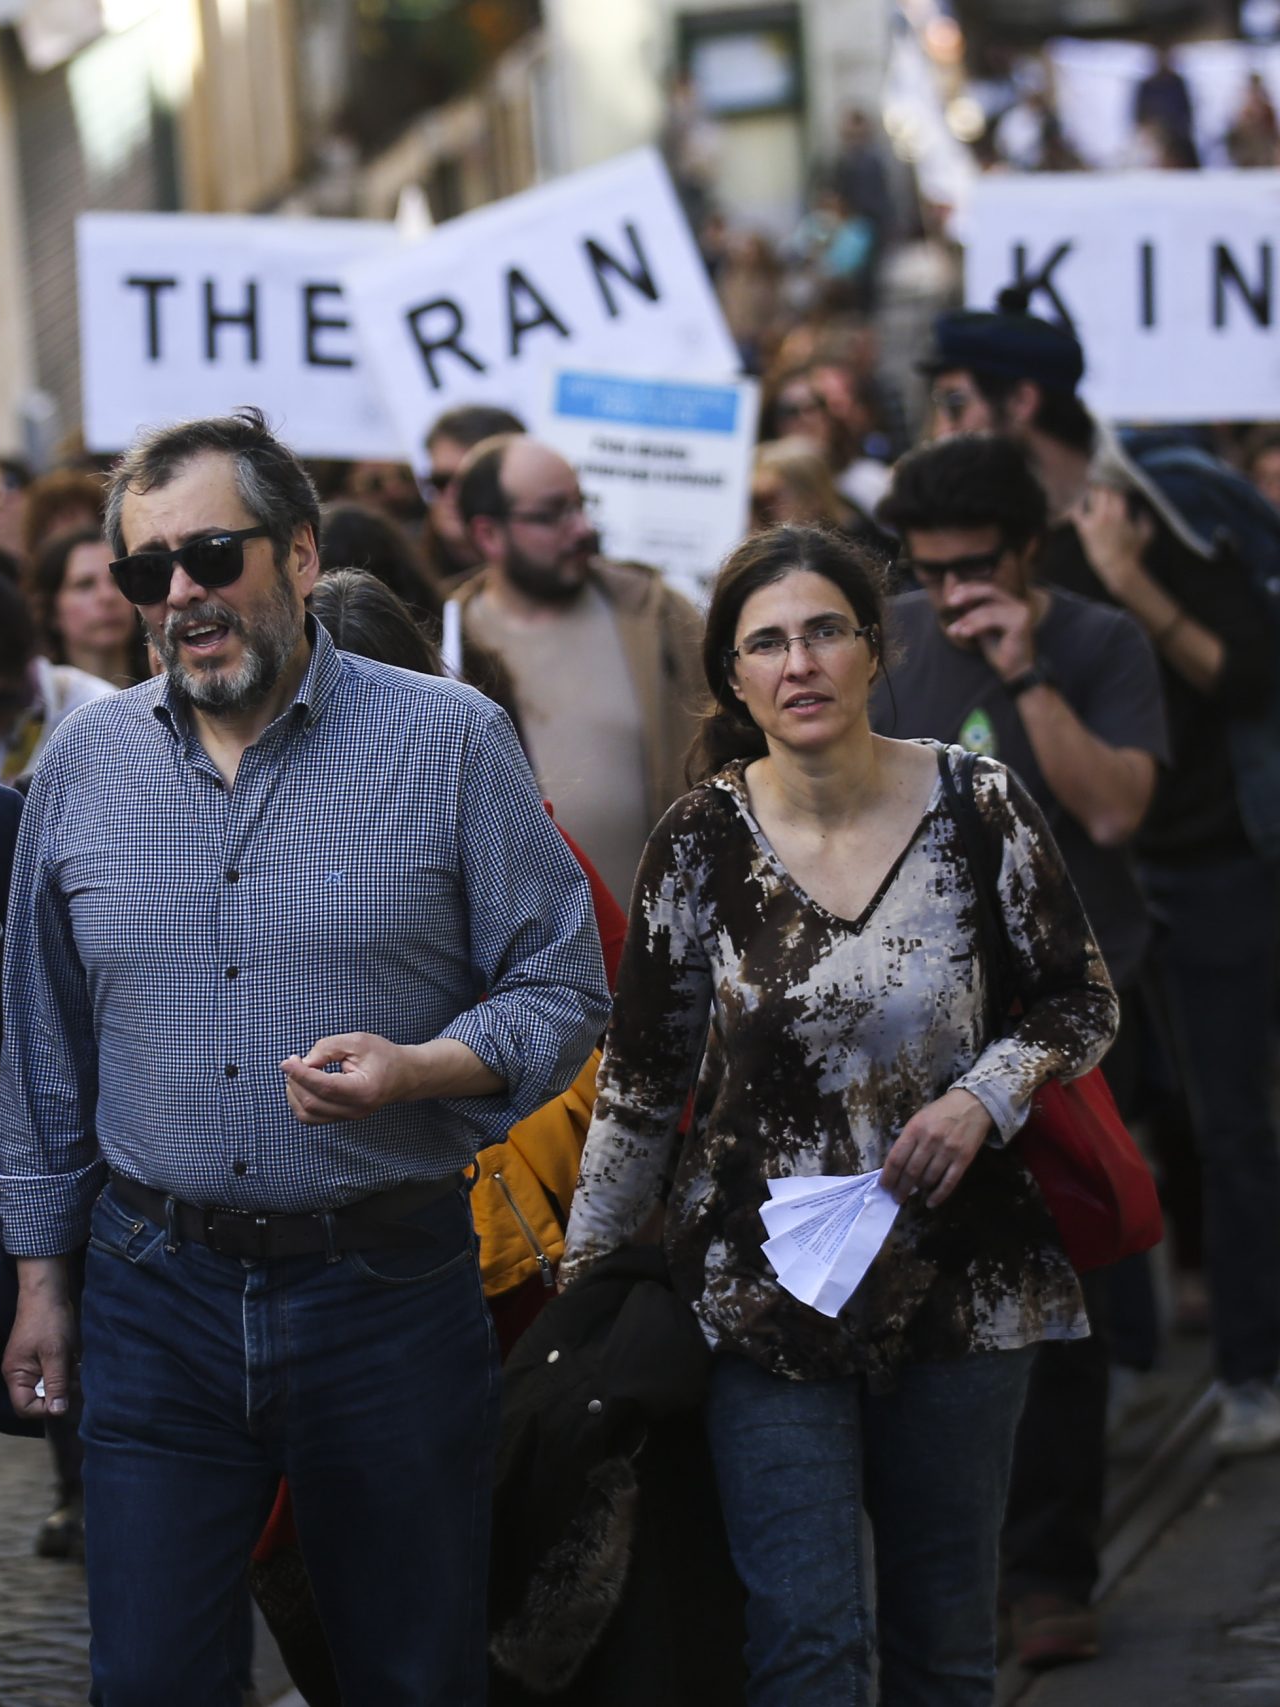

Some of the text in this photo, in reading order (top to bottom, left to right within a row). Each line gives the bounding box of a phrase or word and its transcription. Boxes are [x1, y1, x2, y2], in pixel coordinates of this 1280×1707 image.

[126, 276, 354, 368] THE
[404, 222, 661, 389] RAN
[1010, 240, 1273, 330] KIN
